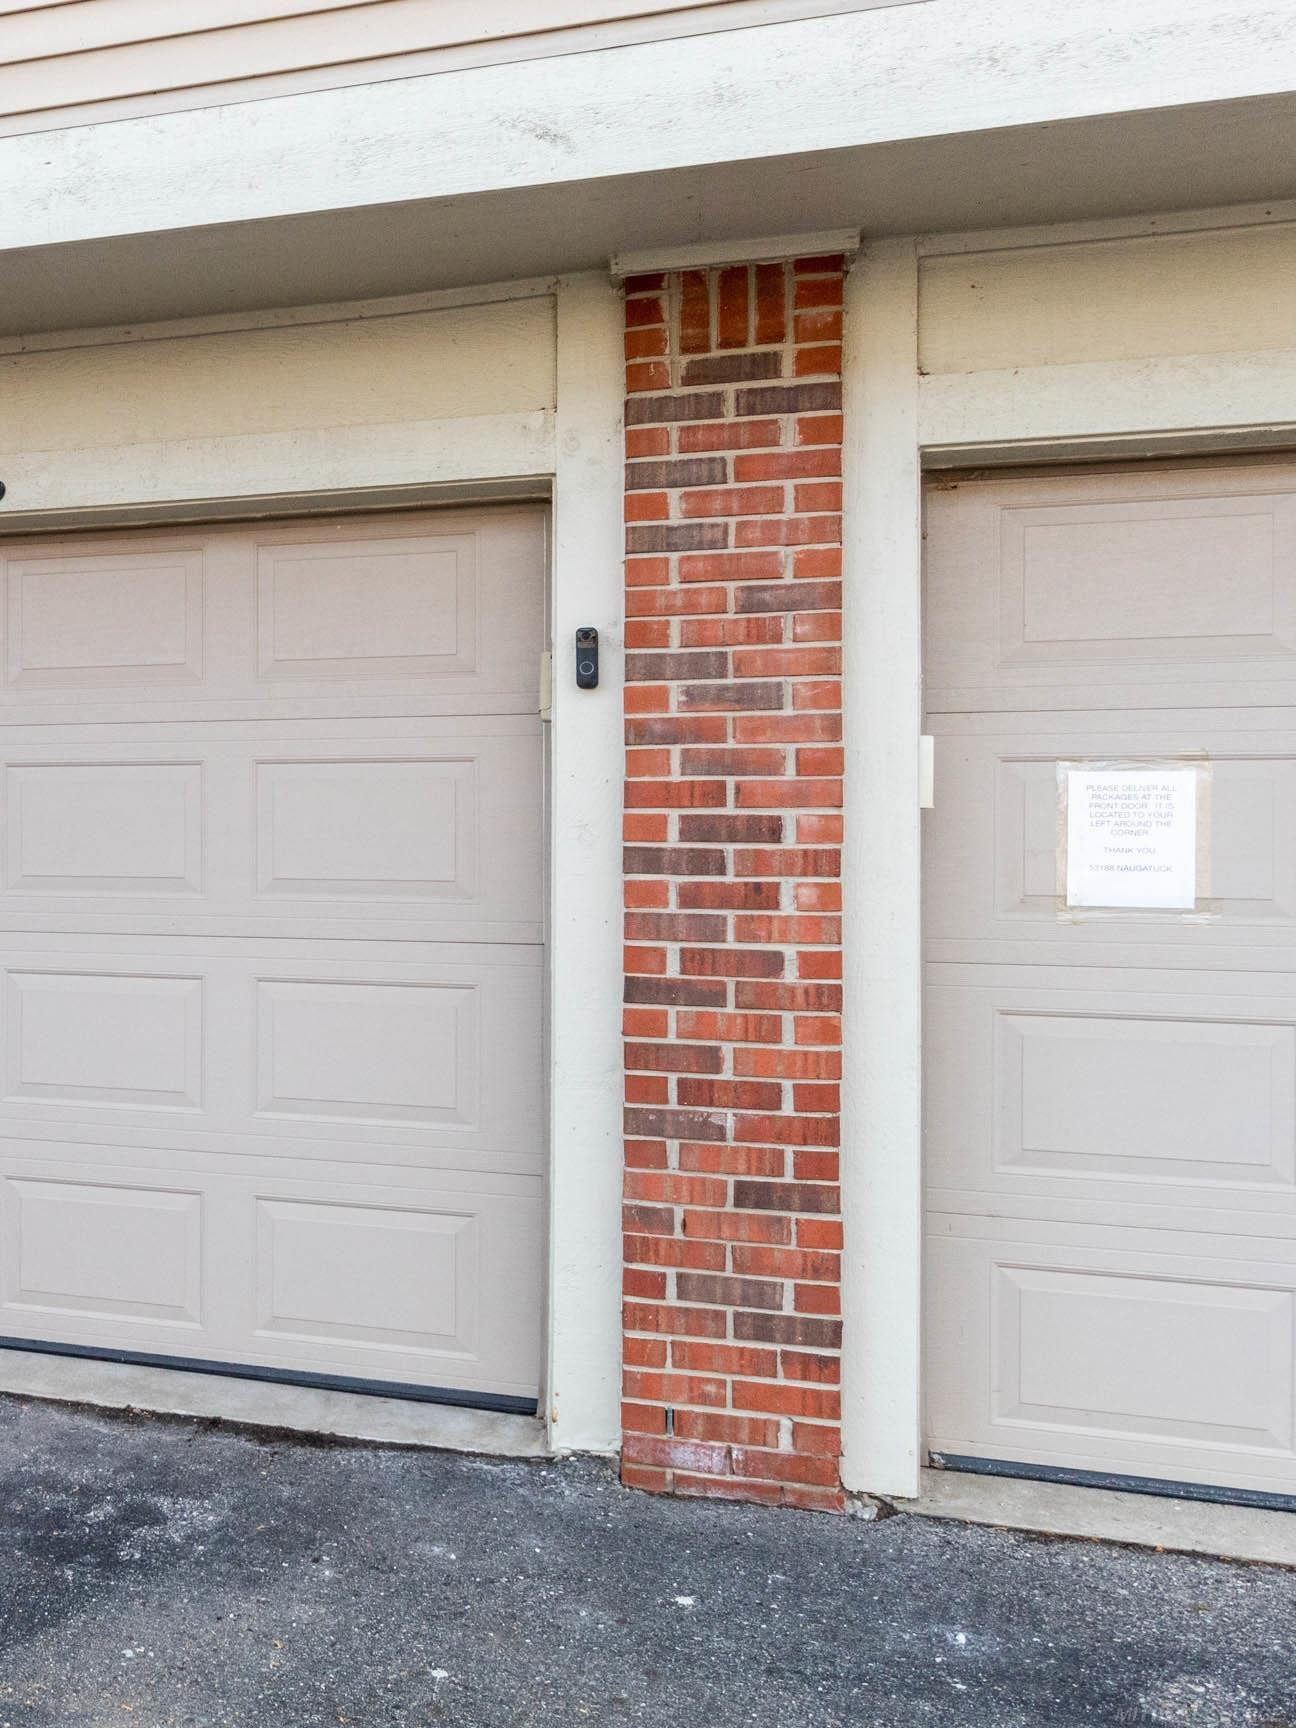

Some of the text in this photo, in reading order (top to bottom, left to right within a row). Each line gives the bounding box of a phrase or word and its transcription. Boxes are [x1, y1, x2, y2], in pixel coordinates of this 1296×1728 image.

[1086, 784, 1119, 792] PLEASE
[1161, 784, 1177, 792] ALL
[1141, 793, 1152, 801] AT
[1155, 793, 1174, 801] THE
[1088, 802, 1119, 810] FRONT
[1089, 811, 1174, 819] LOCATED TO YOUR
[1090, 820, 1174, 828] LEFT AROUND THE
[1104, 846, 1134, 854] THANK
